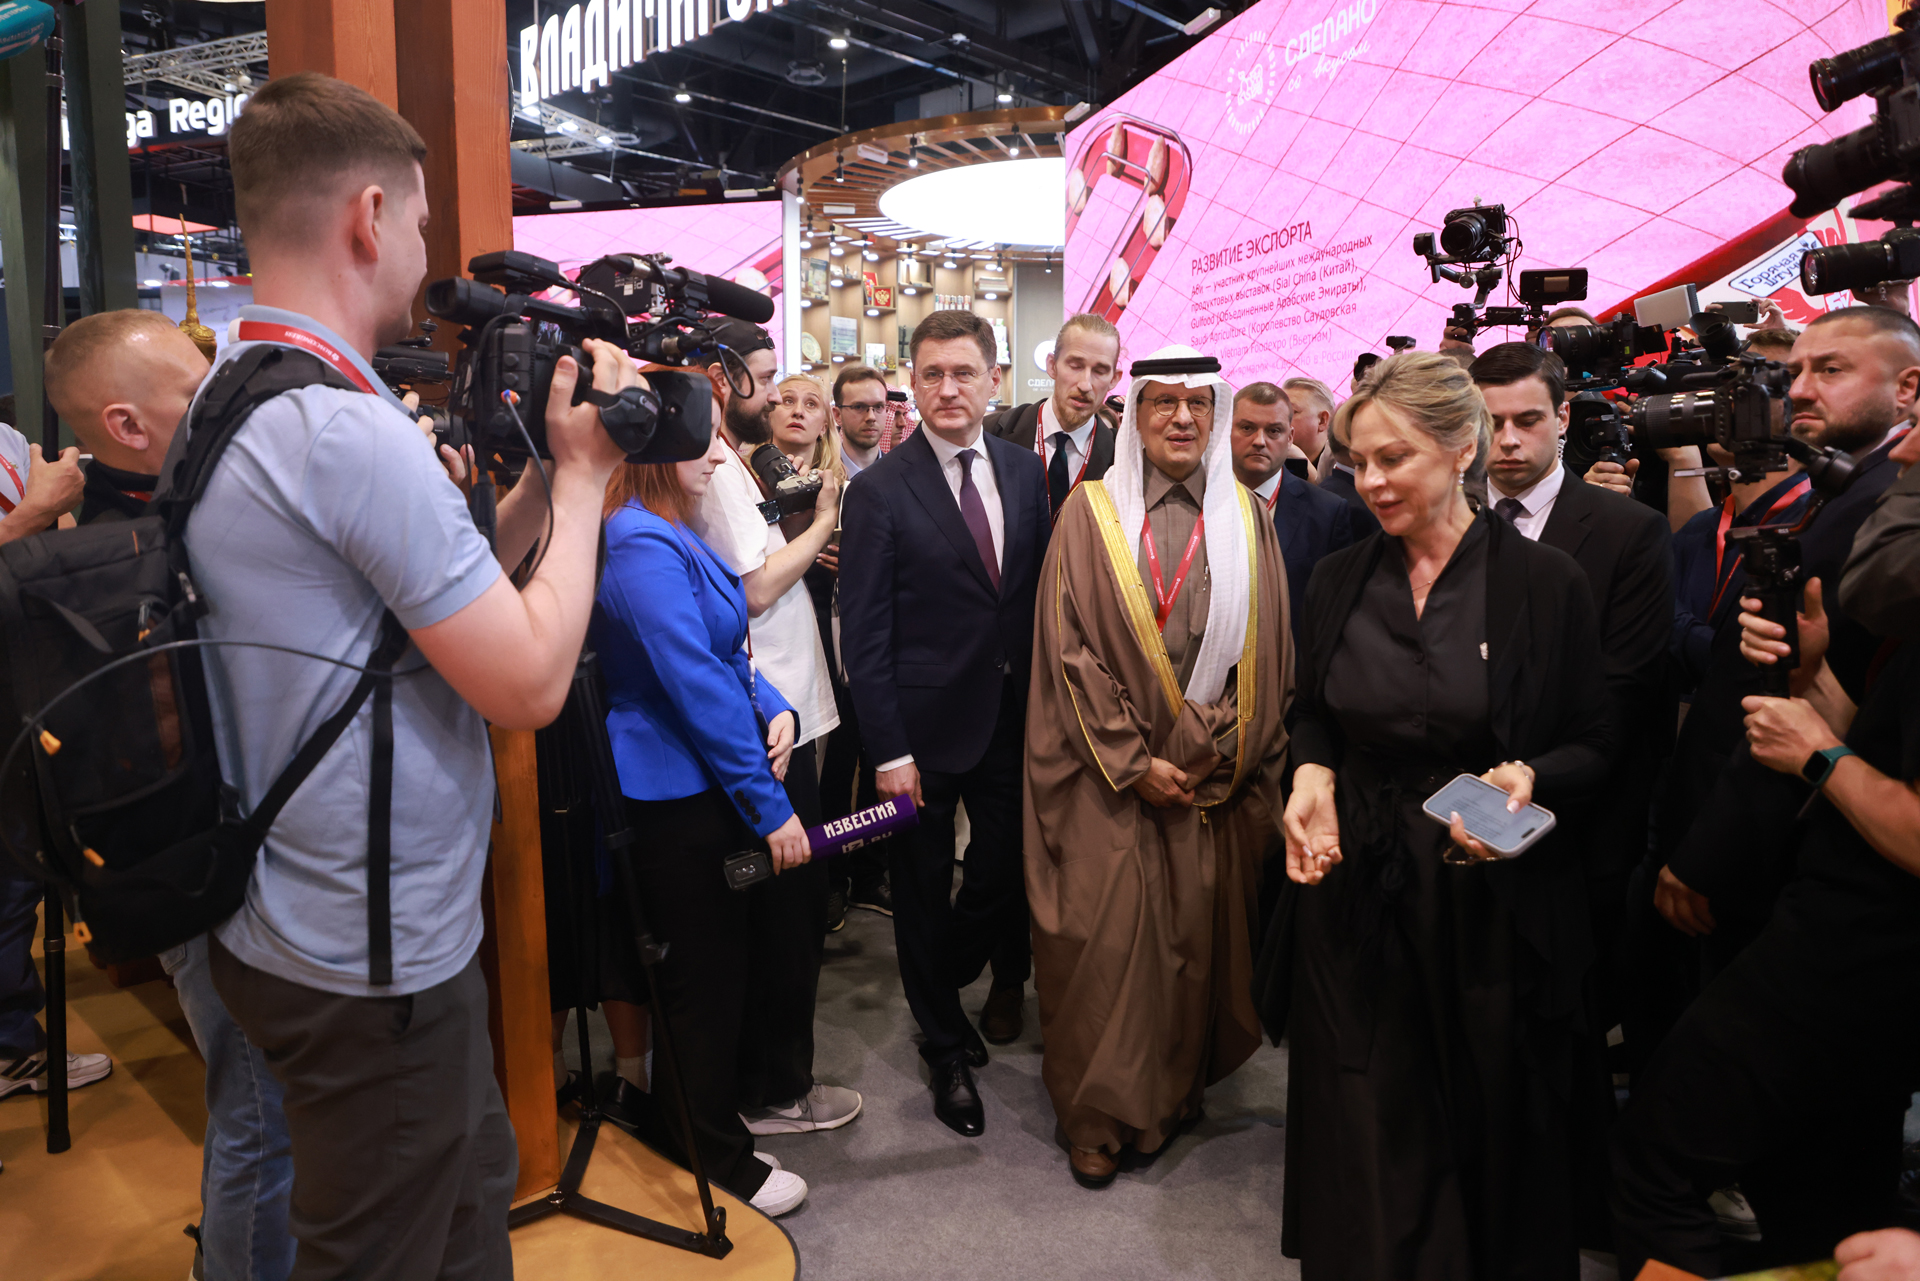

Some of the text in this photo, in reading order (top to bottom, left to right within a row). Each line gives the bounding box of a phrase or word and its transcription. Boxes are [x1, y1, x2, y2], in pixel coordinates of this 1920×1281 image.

[1285, 0, 1376, 66] СДЕЛАНО
[1288, 40, 1371, 92] со вкусом
[1191, 220, 1312, 276] РАЗВИТИЕ ЭКСПОРТА
[1213, 273, 1245, 292] участник
[1247, 259, 1295, 281] крупнейших
[1298, 235, 1372, 264] международных
[1738, 253, 1799, 289] Горячая
[1763, 261, 1800, 287] штуч
[1191, 258, 1357, 313] продуктовых выставок (Sial China (Китай),
[1191, 313, 1214, 329] Gulfood
[1276, 291, 1315, 310] Арабские
[1318, 277, 1366, 299] Эмираты),
[1290, 327, 1331, 349] (Вьетнам)
[1304, 303, 1356, 323] Саудовская
[823, 801, 897, 839] ИЗВЕСТИЯ
